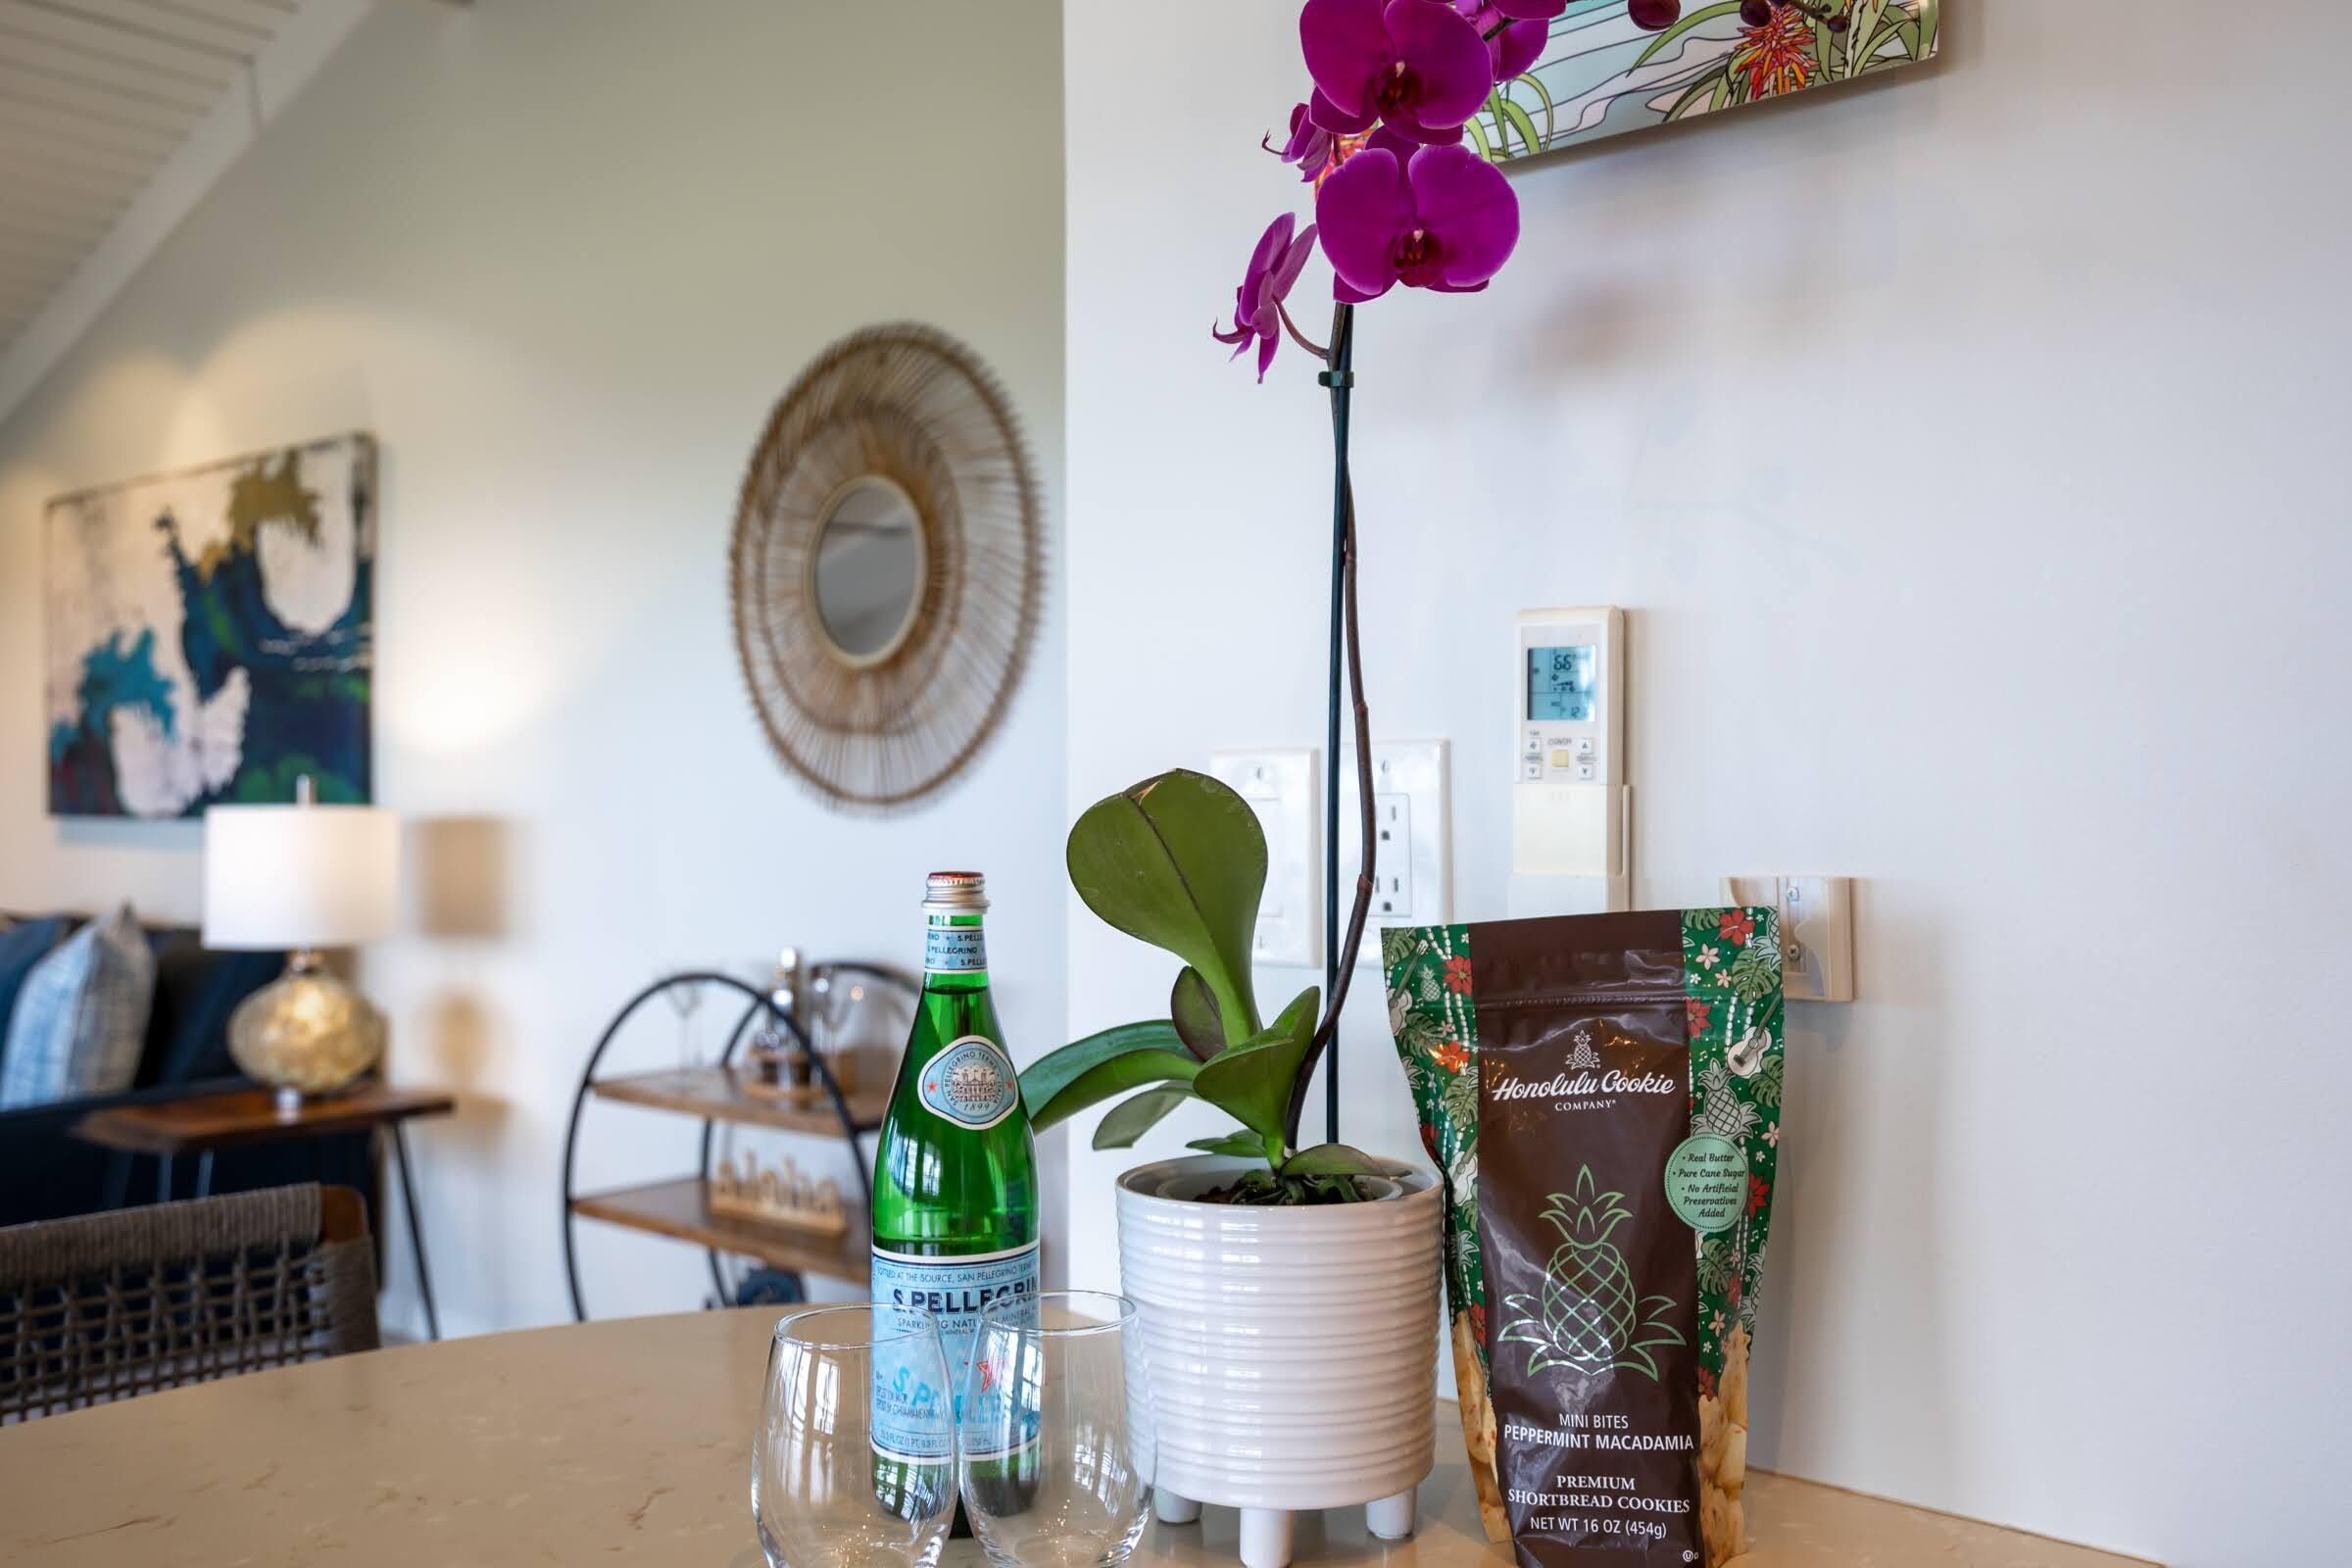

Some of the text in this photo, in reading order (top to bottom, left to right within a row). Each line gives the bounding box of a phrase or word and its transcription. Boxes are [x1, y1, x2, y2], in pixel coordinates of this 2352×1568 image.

[1493, 1069, 1677, 1102] Honolulu Cookie
[1688, 1152, 1735, 1162] Real Butter
[1678, 1169, 1745, 1180] Pure Cane Sugar
[1688, 1184, 1740, 1194] No Artificial
[1684, 1197, 1738, 1205] Preservatives
[1698, 1208, 1726, 1217] Added
[920, 1274, 955, 1283] SOURCE,
[957, 1273, 975, 1282] SAN
[977, 1265, 1017, 1280] PELLEGRINO
[1559, 1413, 1629, 1429] MINI BITES
[1504, 1424, 1694, 1451] PEPPERMINT MACADAMIA
[1556, 1475, 1636, 1491] PREMIUM
[1508, 1489, 1690, 1514] SHORTBREAD COOKIES
[1530, 1517, 1667, 1540] NET WT 16 OZ (454g)
